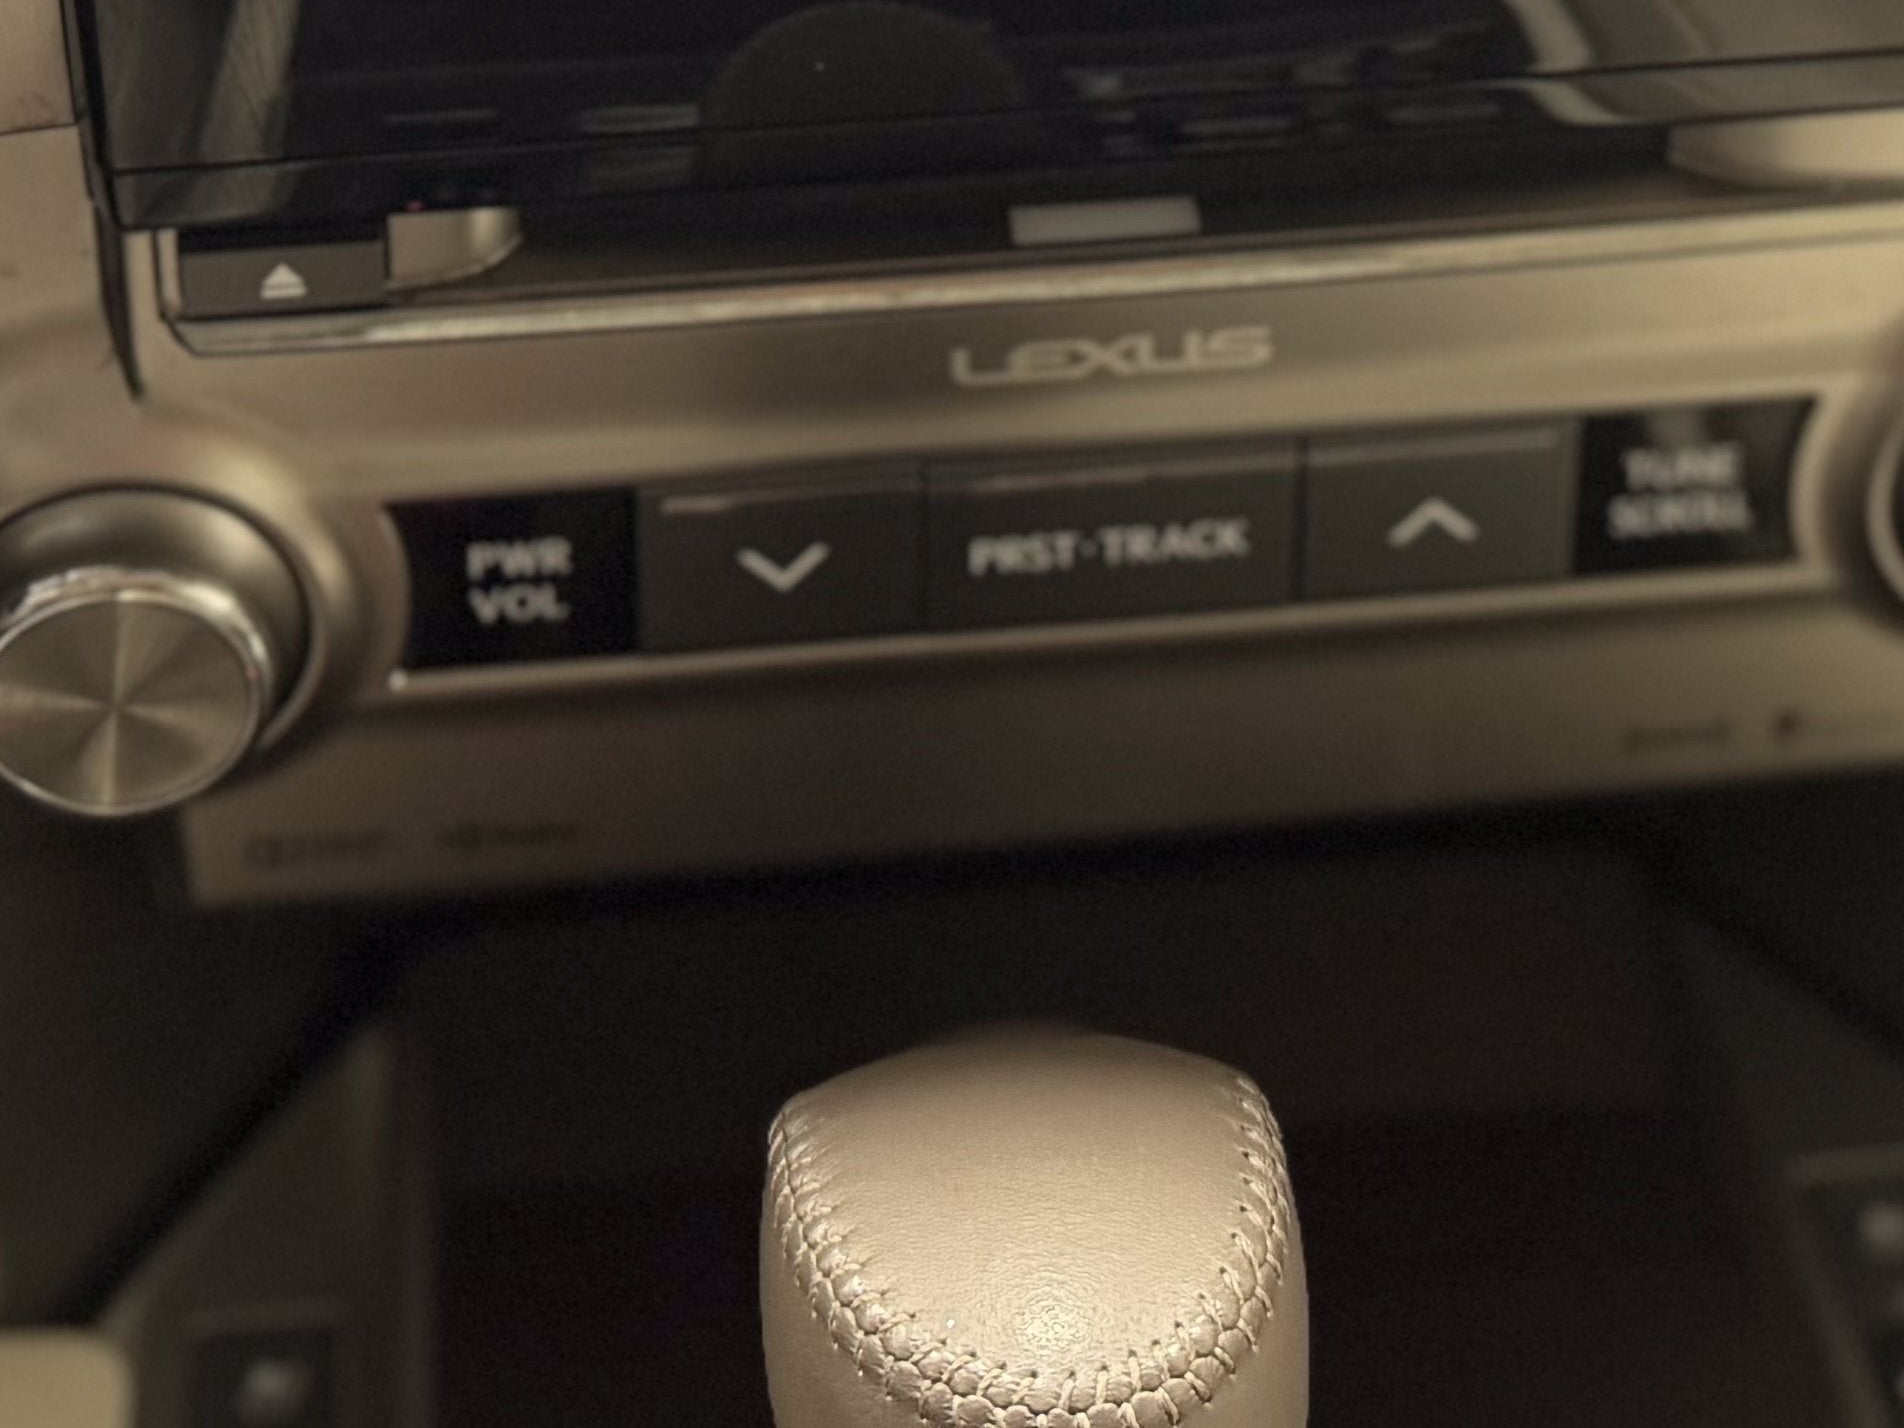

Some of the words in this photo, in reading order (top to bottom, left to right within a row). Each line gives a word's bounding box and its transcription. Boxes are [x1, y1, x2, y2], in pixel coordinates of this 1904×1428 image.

[949, 328, 1273, 388] LEXUS
[465, 537, 571, 581] PWR
[468, 583, 571, 625] VOL
